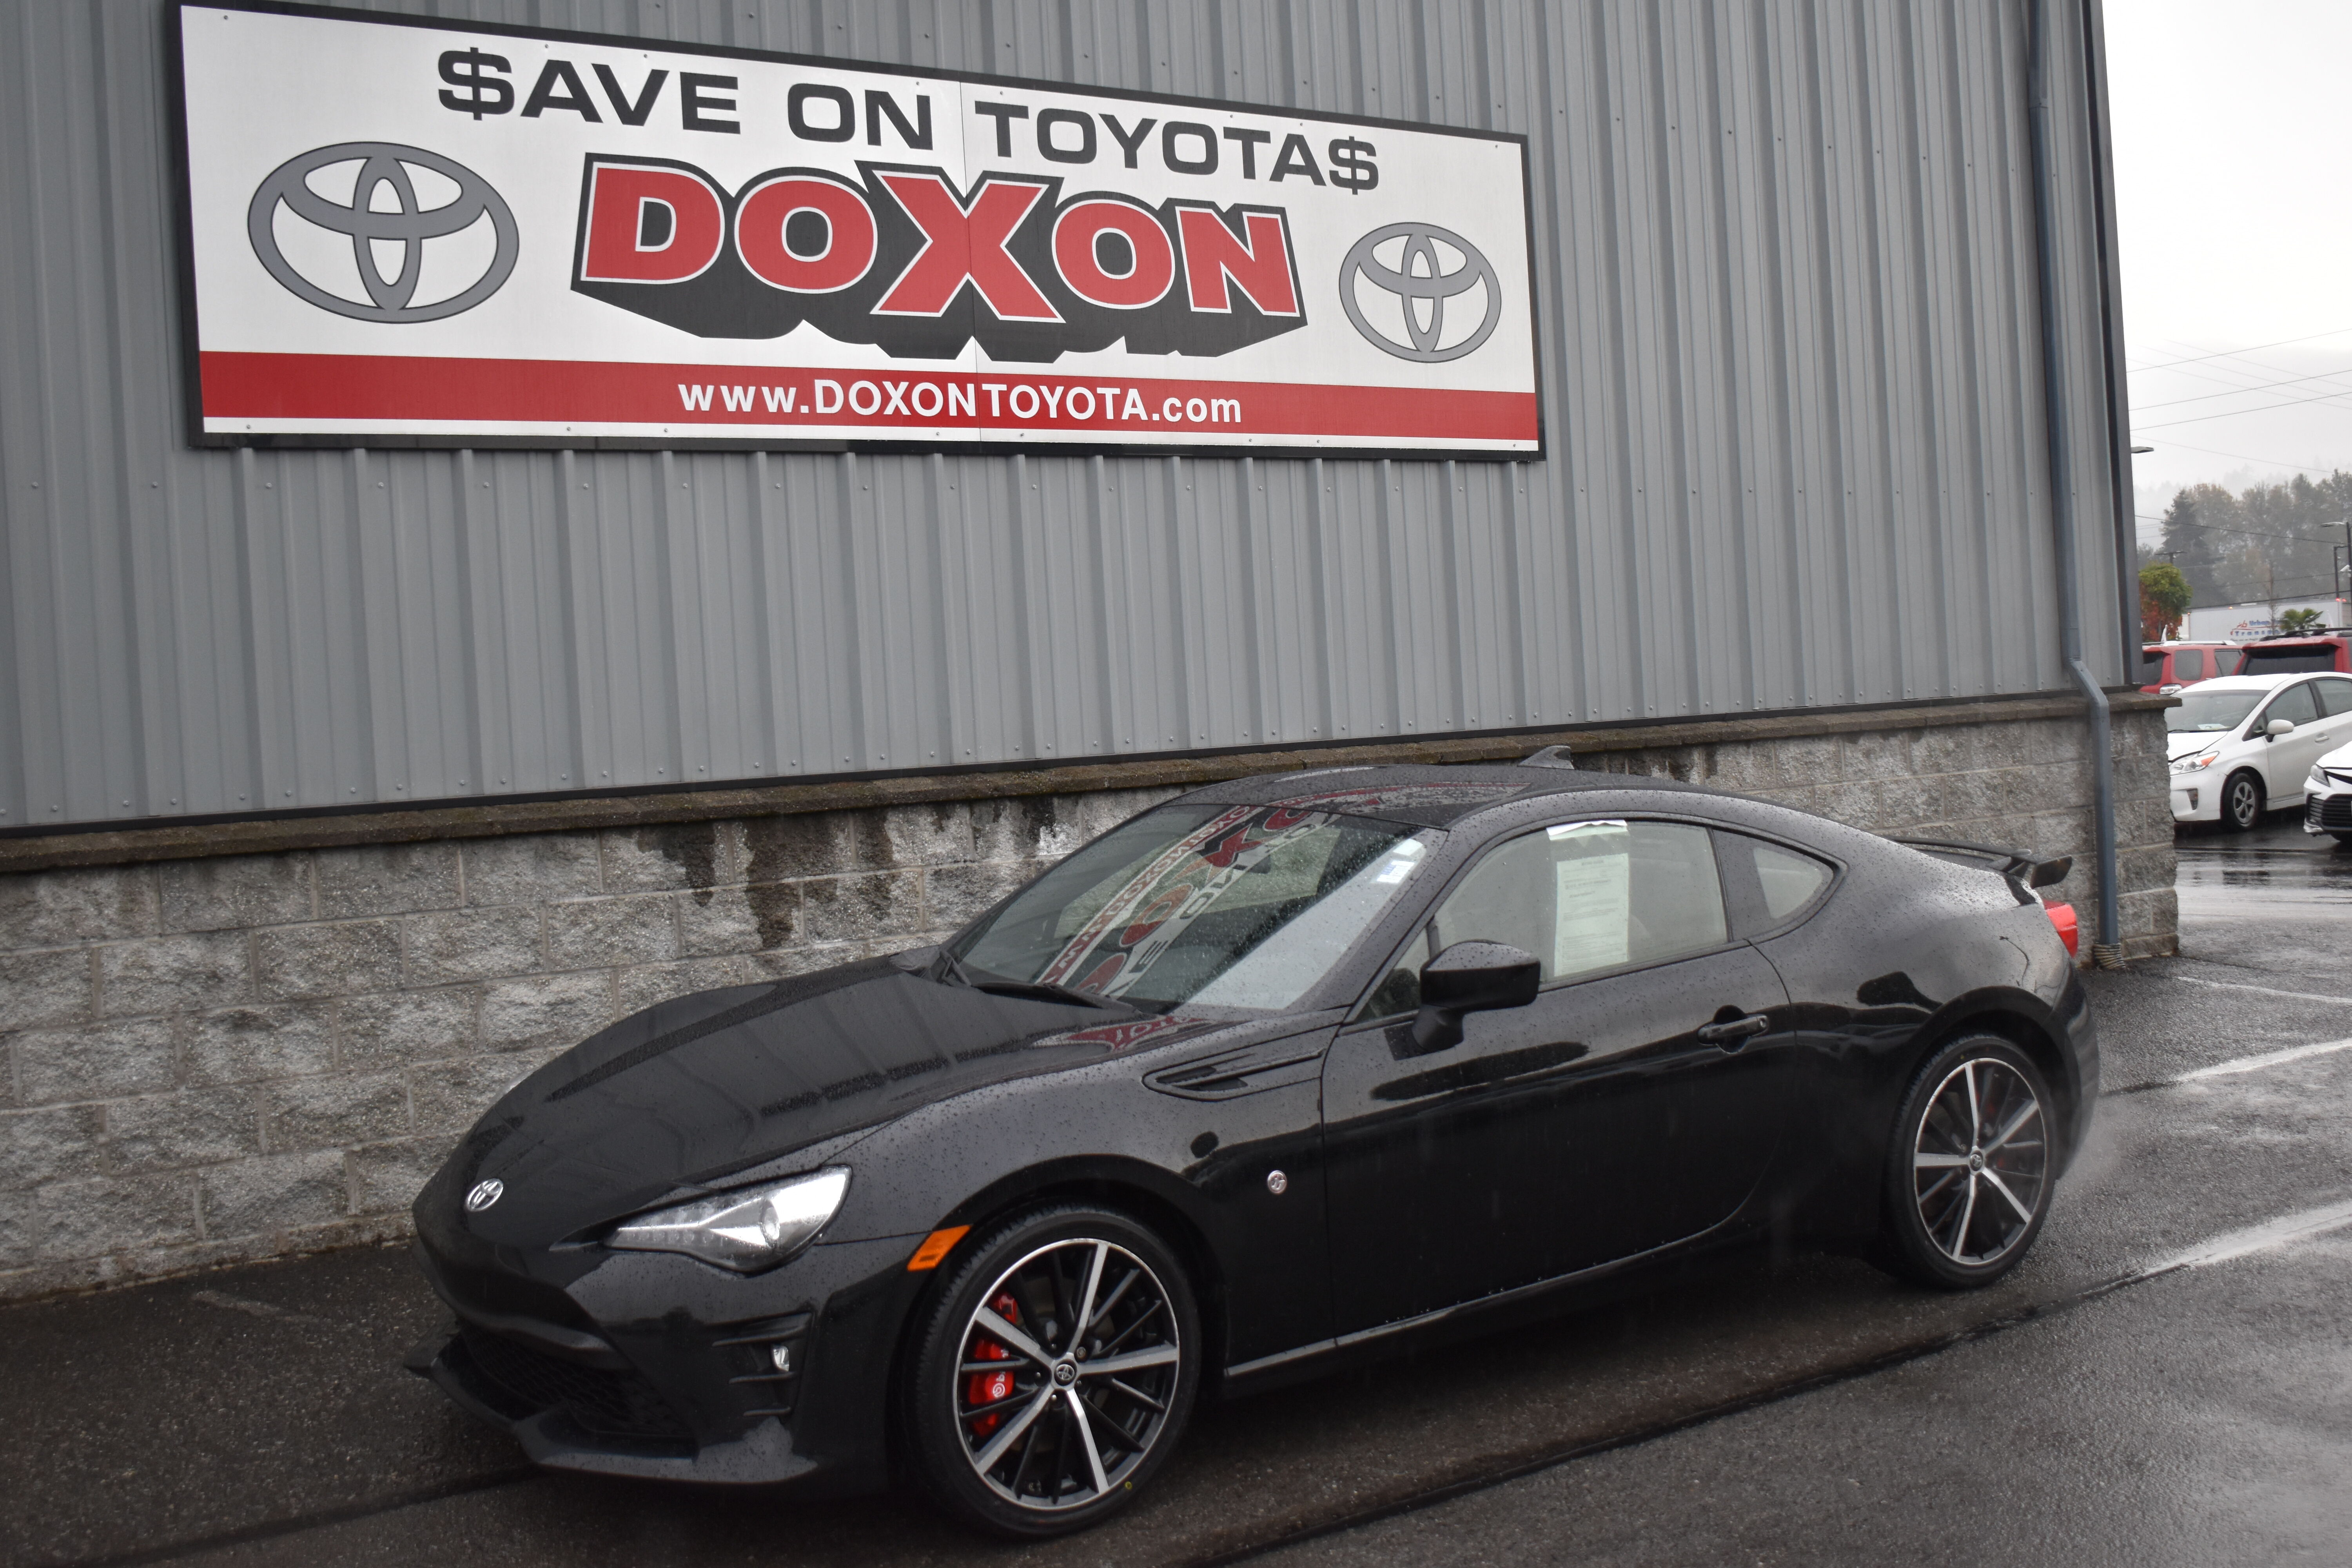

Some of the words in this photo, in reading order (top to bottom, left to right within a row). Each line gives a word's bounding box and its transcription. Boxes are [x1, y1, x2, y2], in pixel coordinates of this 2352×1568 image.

[437, 47, 741, 134] $AVE
[787, 83, 934, 151] ON
[974, 100, 1379, 195] TOYOTA$
[582, 163, 1301, 323] DOXON
[677, 379, 1241, 423] www.DOXONTOYOTA.com
